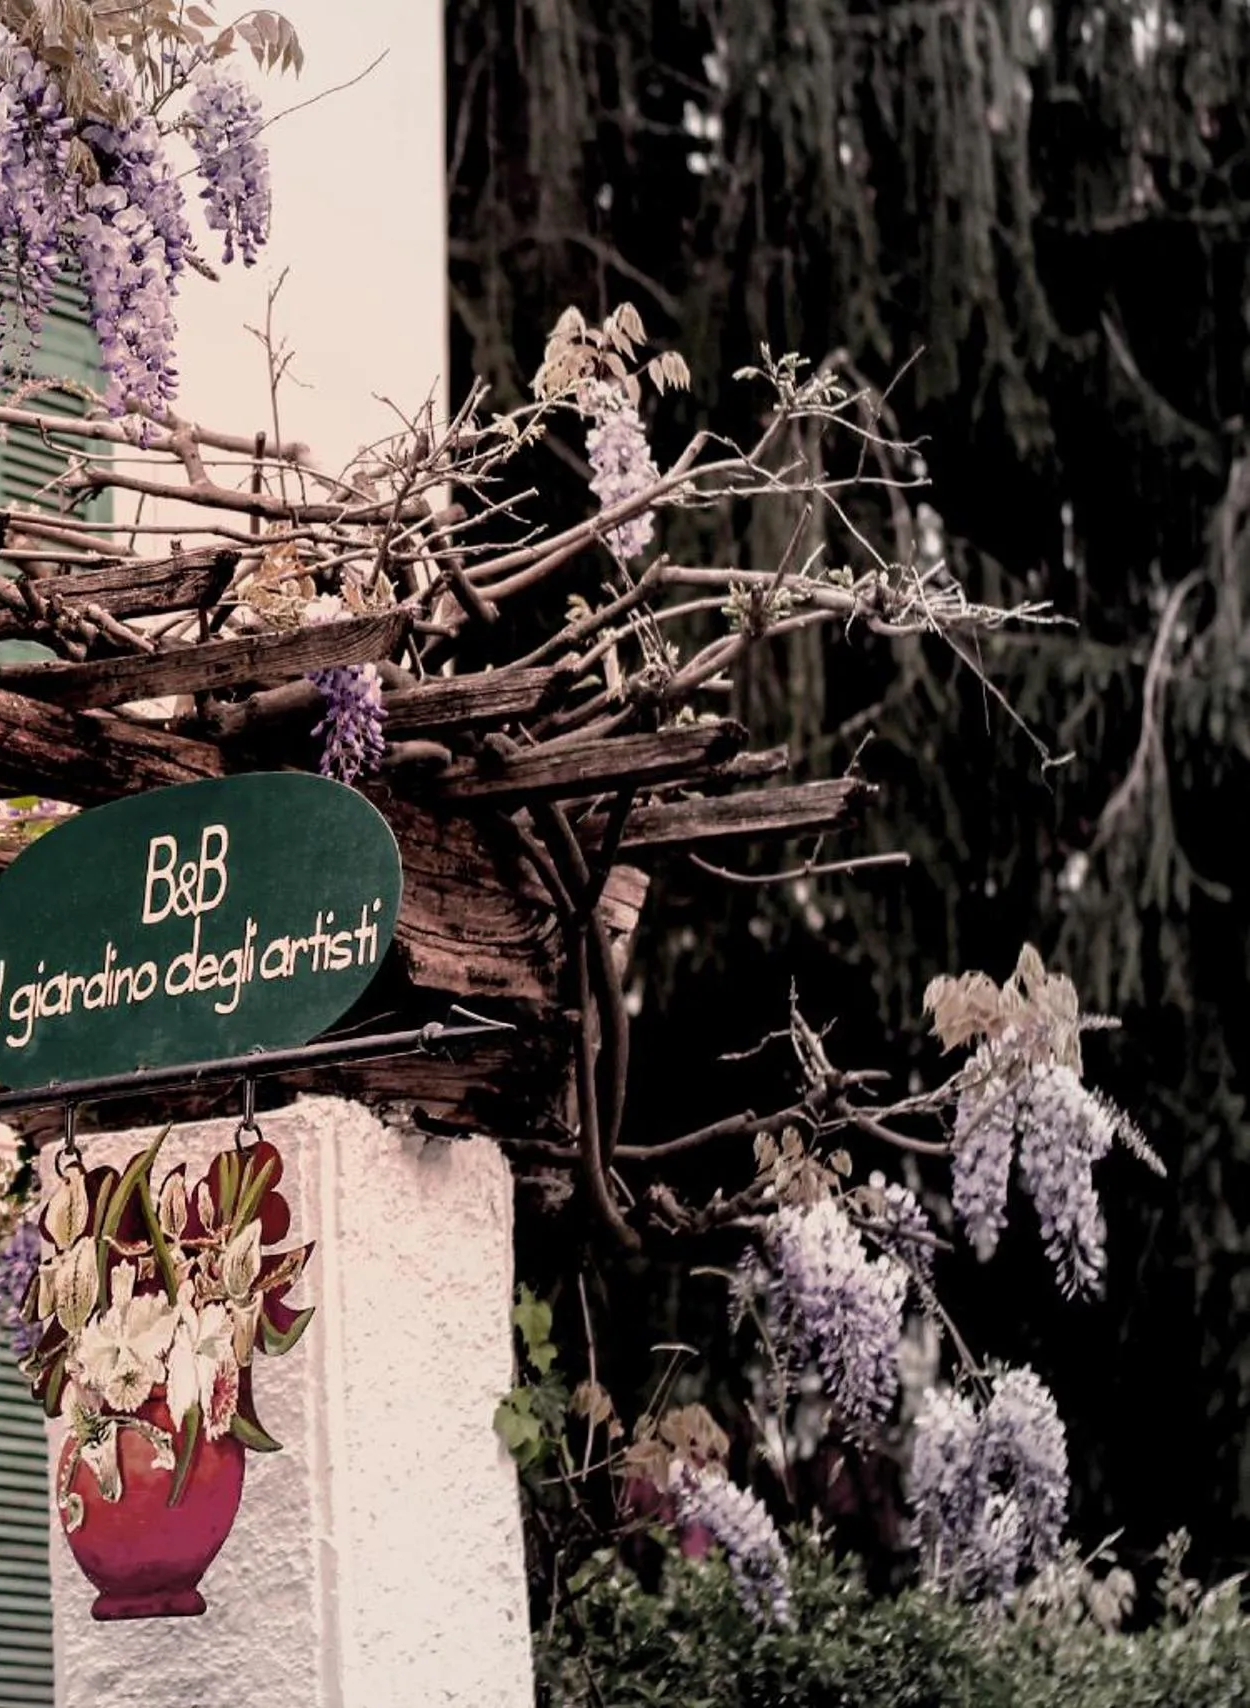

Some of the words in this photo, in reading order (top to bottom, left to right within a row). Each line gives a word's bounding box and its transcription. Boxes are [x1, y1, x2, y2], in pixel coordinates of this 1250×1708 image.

[141, 823, 229, 924] B&B
[5, 941, 158, 1048] giardino
[164, 914, 257, 1015] degli
[259, 897, 382, 980] artisti
